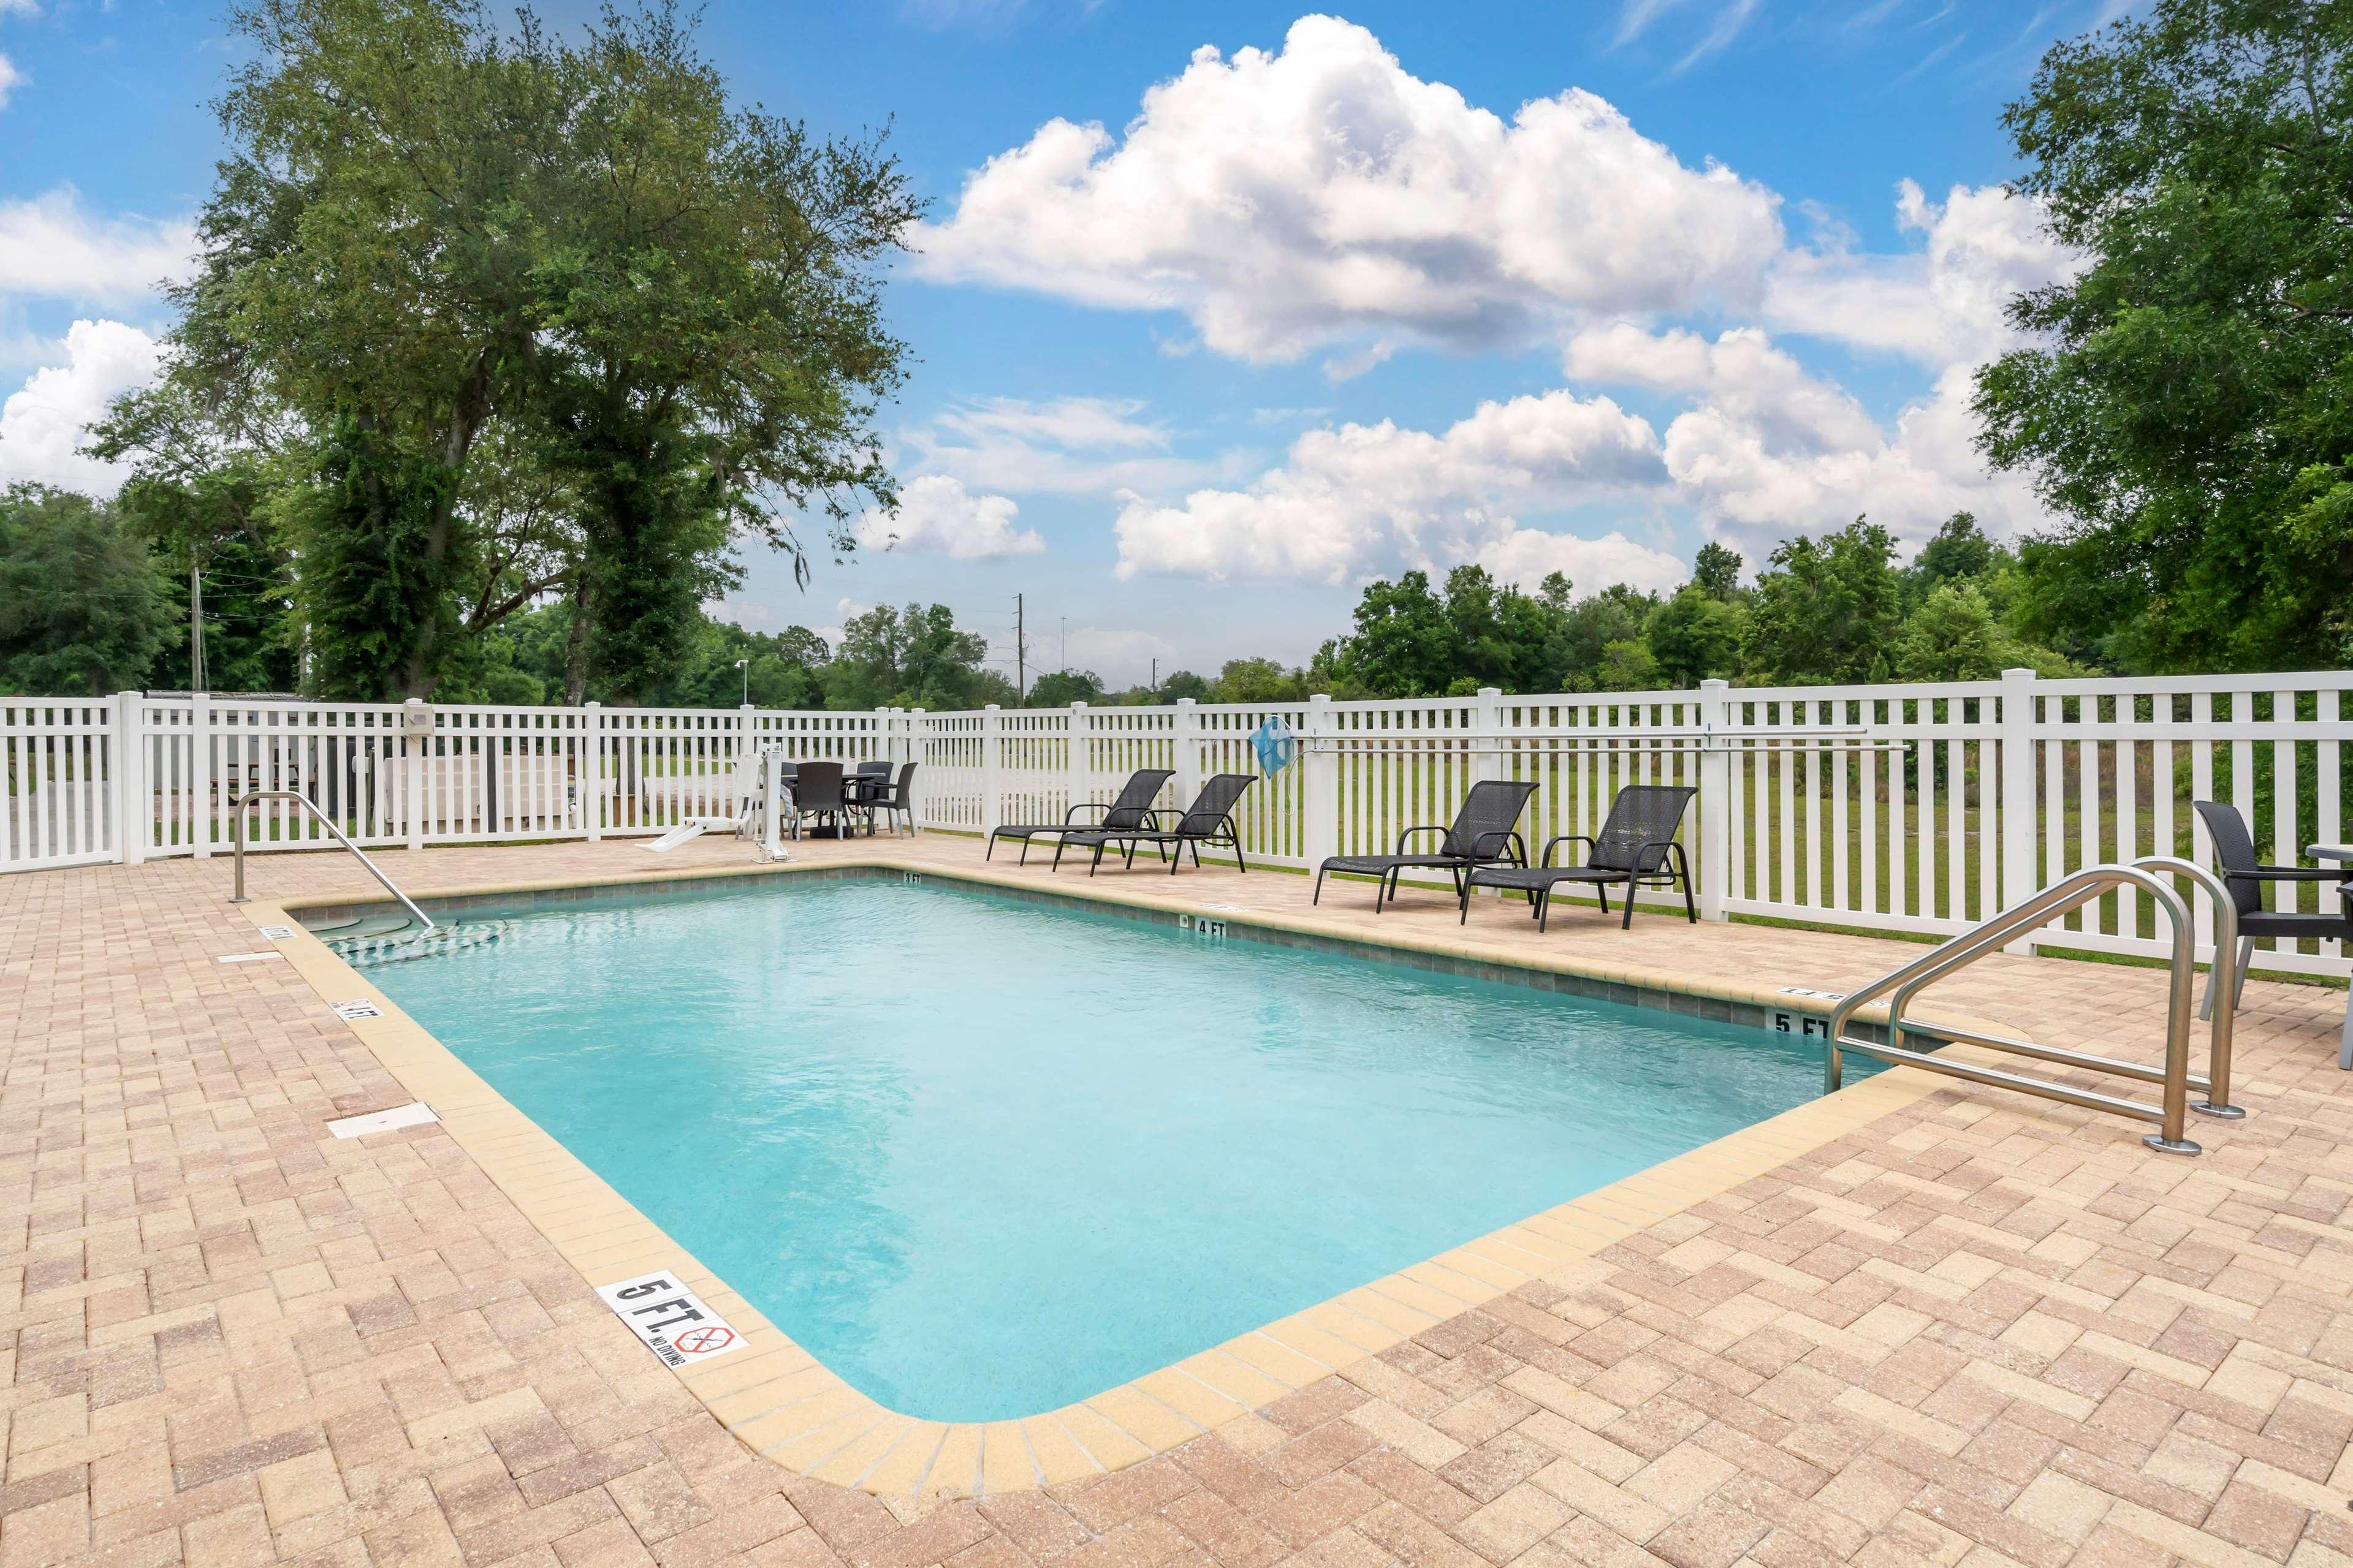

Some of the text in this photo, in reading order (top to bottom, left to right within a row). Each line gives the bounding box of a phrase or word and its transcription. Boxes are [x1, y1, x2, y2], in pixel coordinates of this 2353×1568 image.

[913, 874, 920, 884] FT
[1199, 920, 1225, 936] 4 FT
[1775, 1013, 1829, 1039] 5 FT
[617, 1279, 705, 1333] 5 FT.
[648, 1336, 686, 1366] NO DIVING
